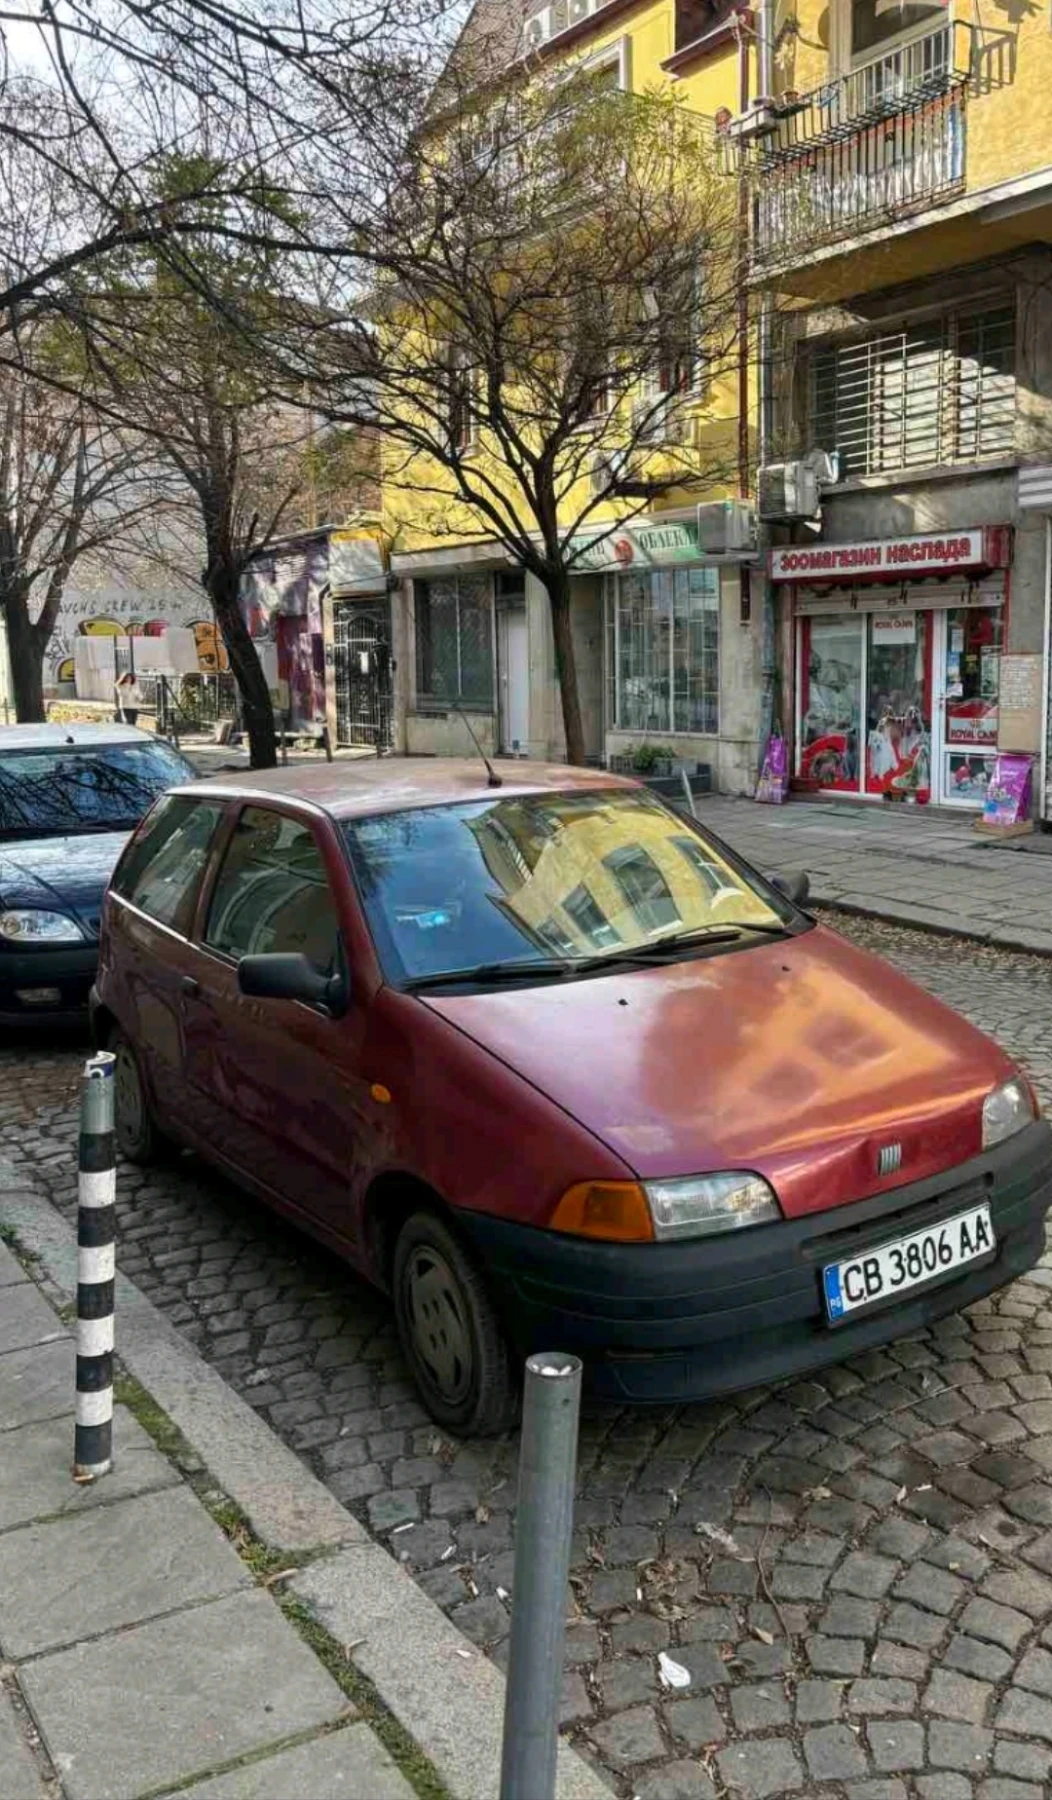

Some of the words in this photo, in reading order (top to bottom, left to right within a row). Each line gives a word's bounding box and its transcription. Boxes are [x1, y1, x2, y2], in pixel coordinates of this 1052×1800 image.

[951, 729, 974, 739] ROYAL
[844, 1258, 883, 1302] CB
[889, 1229, 953, 1286] 3806
[960, 1214, 990, 1258] AA
